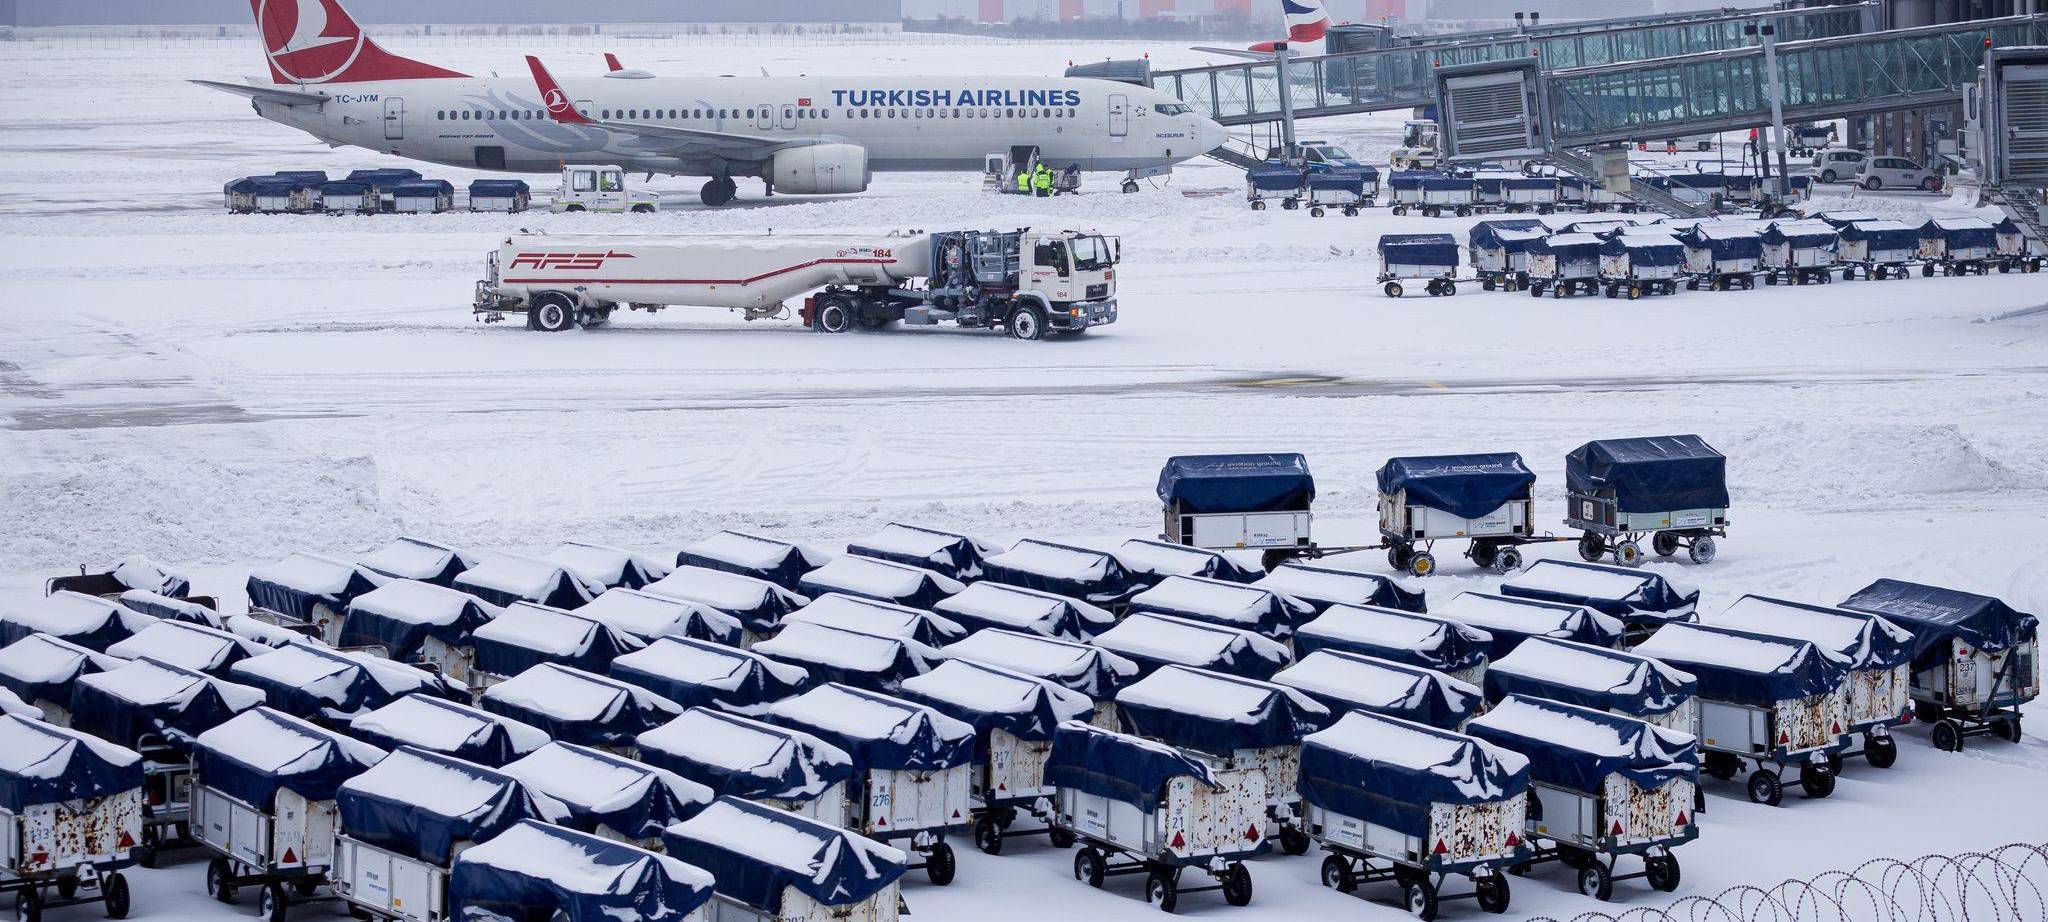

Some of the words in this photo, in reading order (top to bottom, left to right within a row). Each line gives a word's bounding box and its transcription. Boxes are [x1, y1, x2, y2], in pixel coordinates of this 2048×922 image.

[335, 94, 379, 103] TC-JYM
[831, 89, 951, 107] TURKISH
[956, 89, 1081, 107] AIRLINES
[872, 248, 892, 258] 184
[1960, 662, 1976, 672] 237
[872, 794, 890, 807] 276
[1172, 816, 1184, 829] 21
